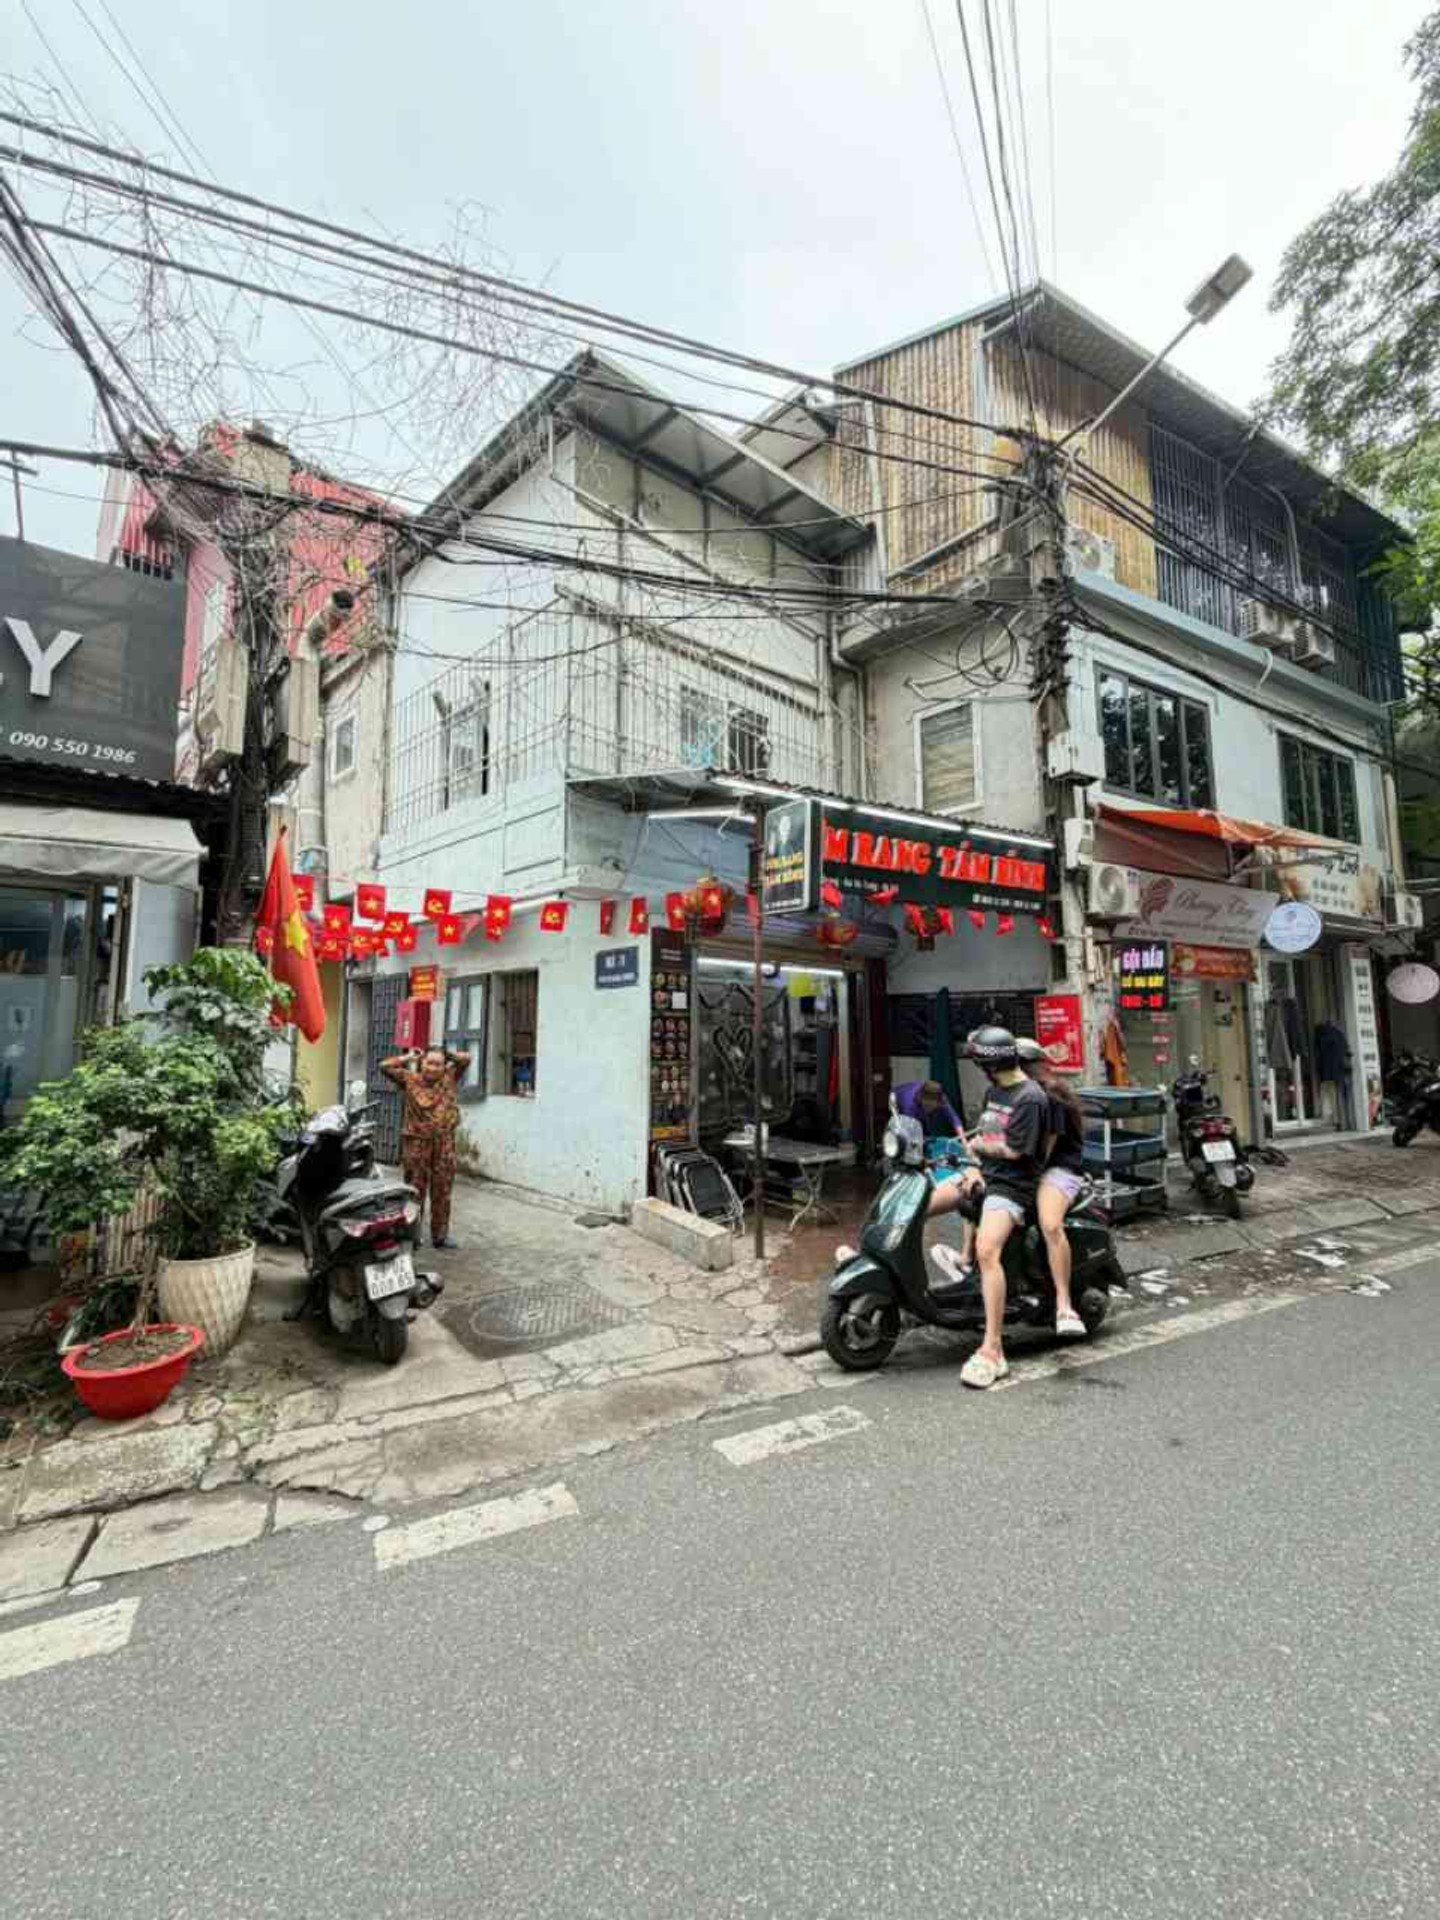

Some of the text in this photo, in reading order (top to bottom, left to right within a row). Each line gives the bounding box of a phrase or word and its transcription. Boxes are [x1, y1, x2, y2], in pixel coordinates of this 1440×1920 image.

[0, 616, 83, 698] Y
[9, 731, 137, 764] 090 550 1986
[851, 832, 932, 875] RANG
